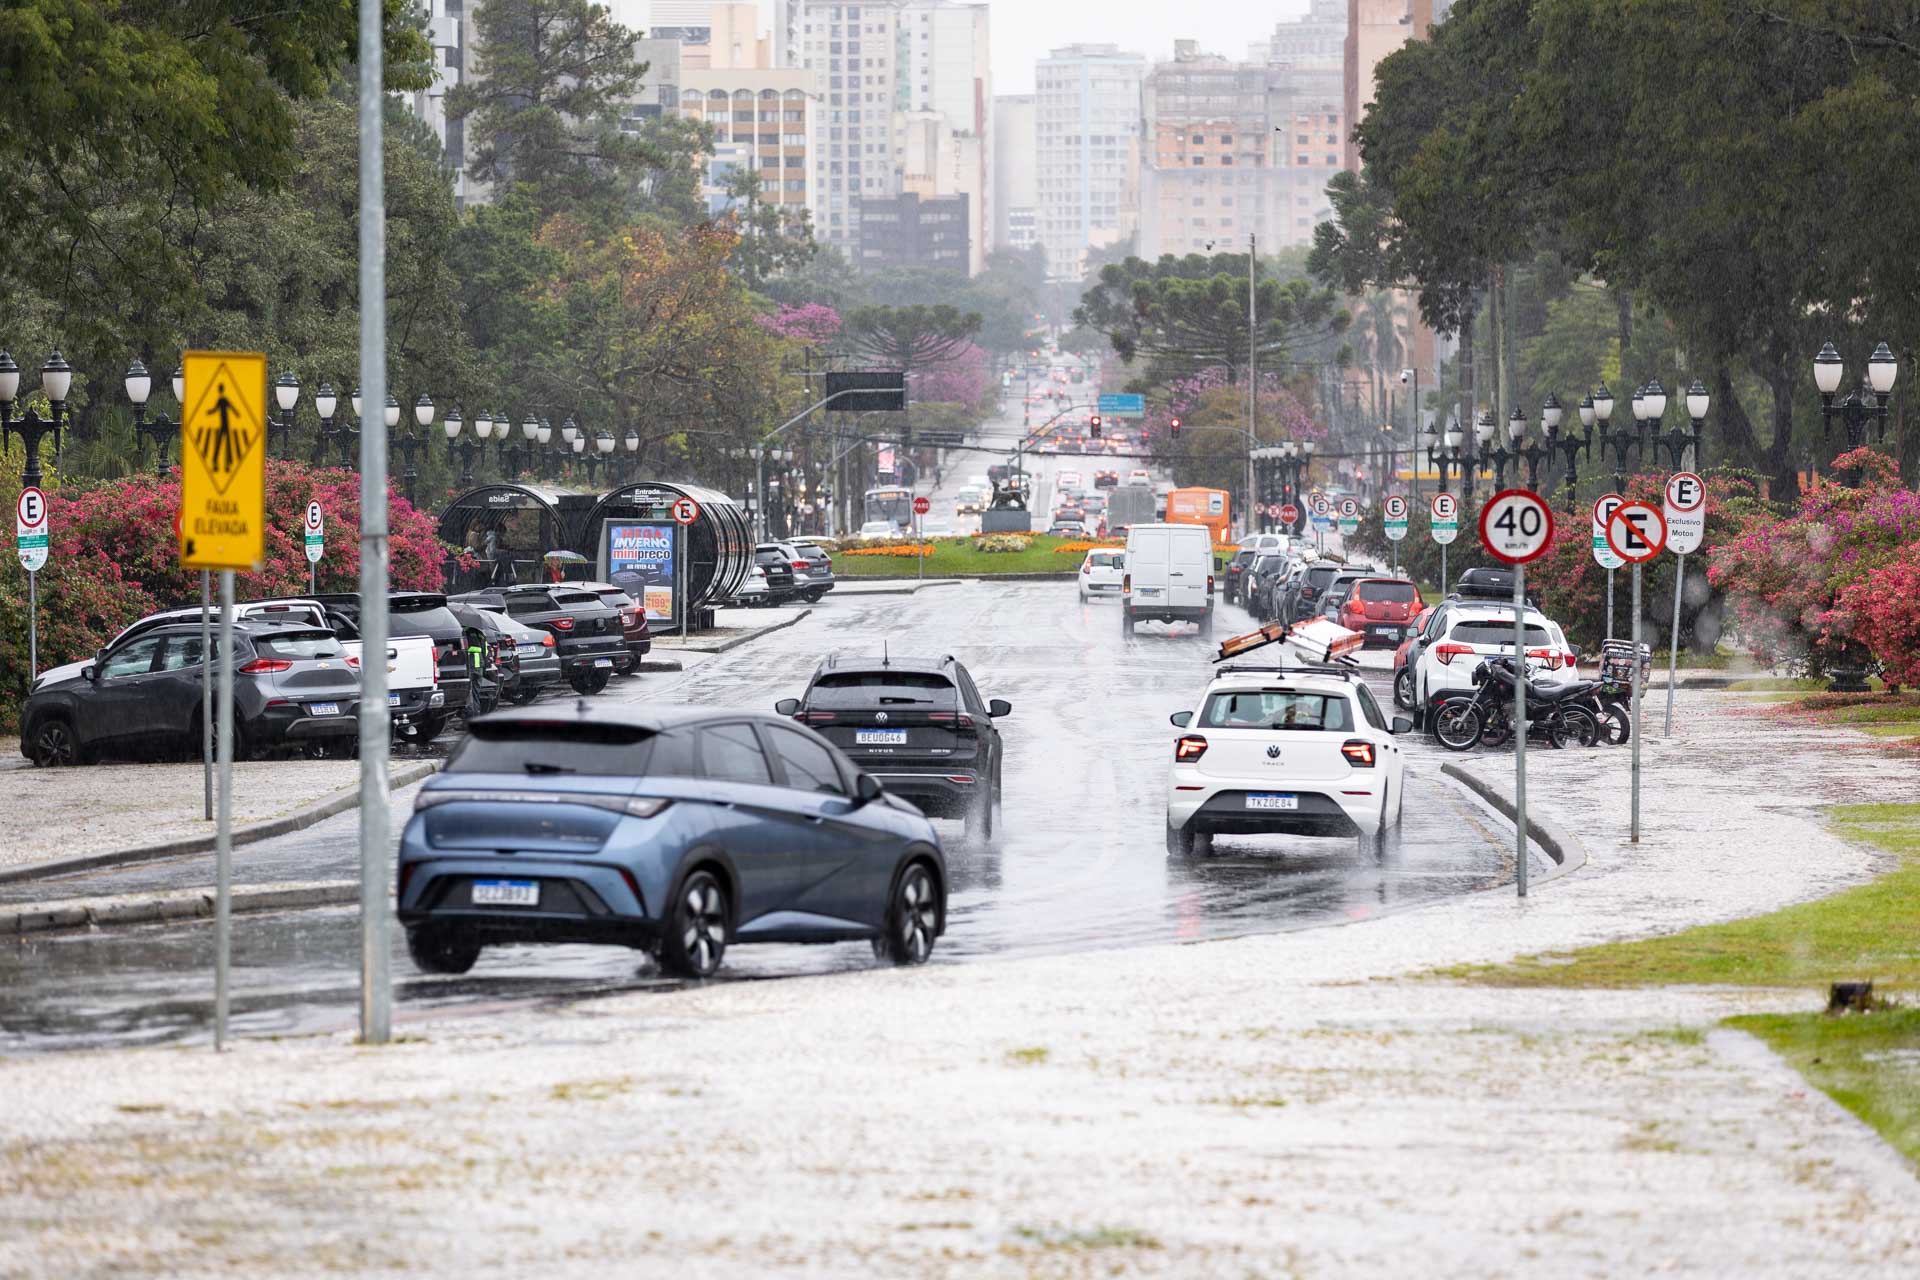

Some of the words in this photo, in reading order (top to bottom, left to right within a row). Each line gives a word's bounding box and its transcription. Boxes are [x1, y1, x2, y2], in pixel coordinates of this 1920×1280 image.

[1677, 480, 1693, 504] E
[27, 496, 37, 518] E
[206, 499, 239, 514] FAIXA
[680, 503, 690, 518] E
[1318, 502, 1325, 512] E
[1345, 502, 1353, 512] E
[1391, 500, 1400, 512] E
[1440, 498, 1449, 512] E
[310, 506, 318, 522] E
[1494, 506, 1541, 536] 40
[194, 518, 249, 536] ELEVADA
[1666, 518, 1701, 526] Exclusivo
[622, 528, 663, 538] MEGA
[1626, 514, 1648, 549] E
[614, 538, 670, 548] INVERNO
